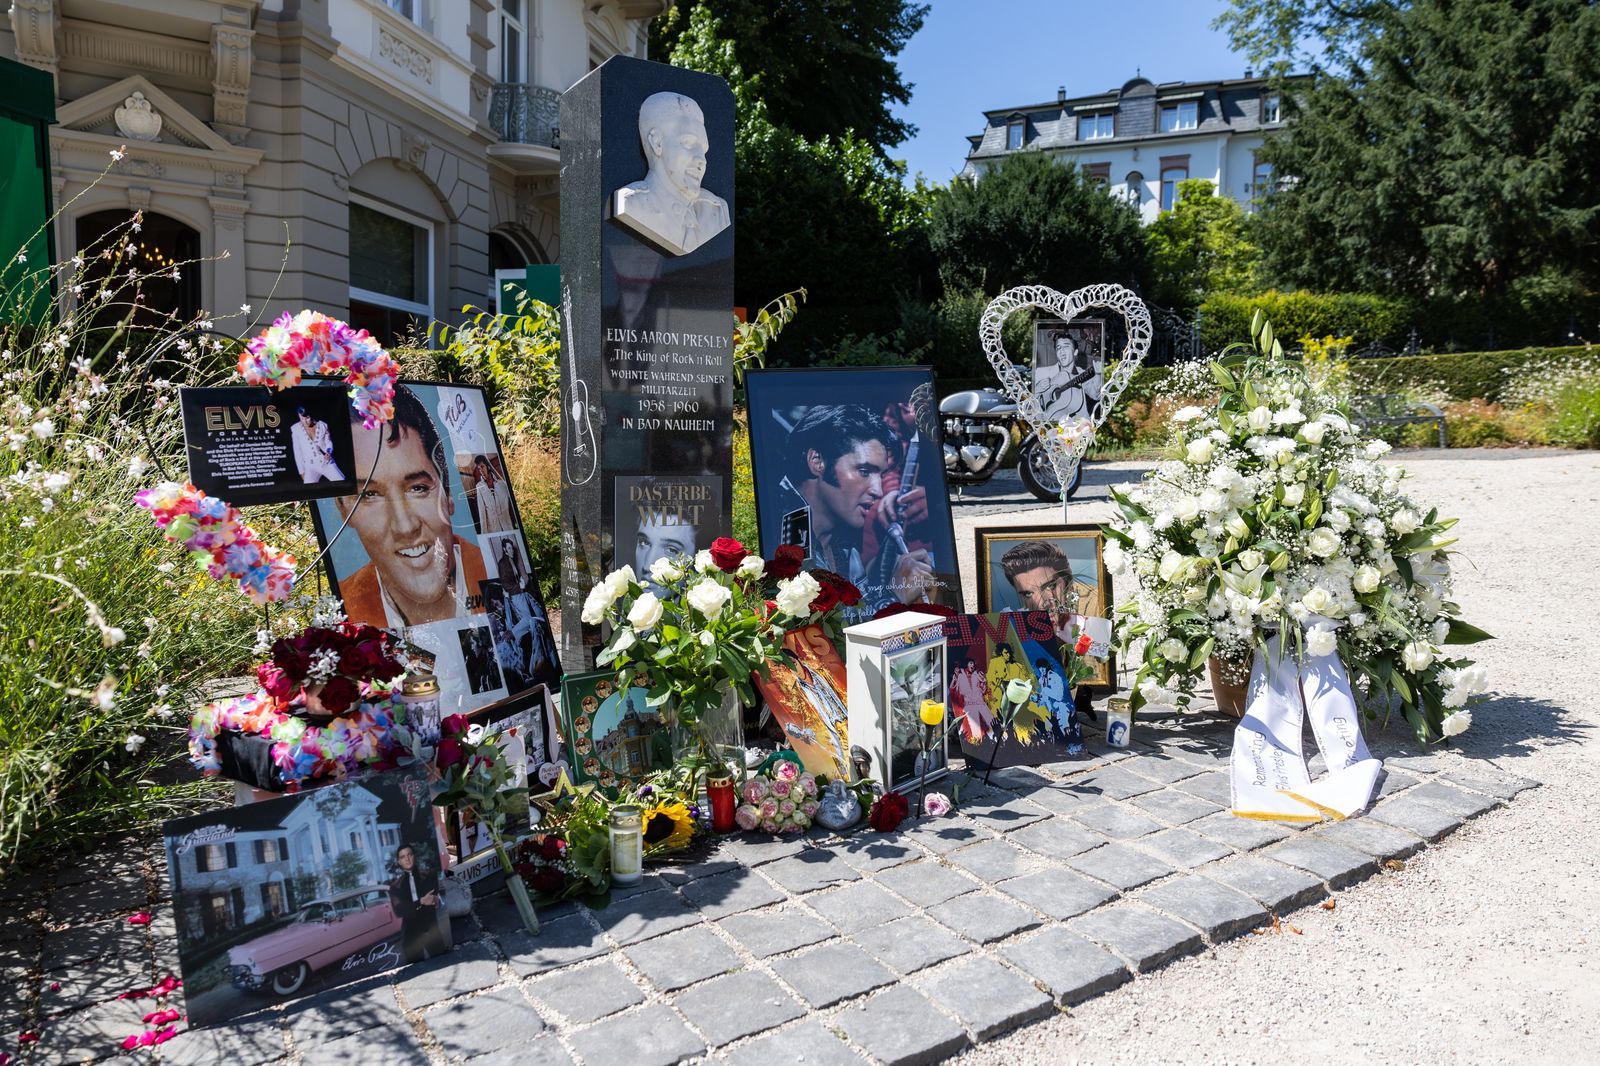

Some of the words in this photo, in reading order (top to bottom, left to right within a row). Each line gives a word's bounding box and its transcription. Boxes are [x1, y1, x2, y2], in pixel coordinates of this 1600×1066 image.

[606, 328, 638, 343] ELVIS
[640, 331, 679, 346] AARON
[683, 333, 728, 349] PRESLEY
[636, 349, 657, 367] King
[660, 352, 669, 362] of
[672, 353, 693, 365] Rock
[705, 355, 722, 366] Roll
[610, 369, 648, 380] WOHNTE
[696, 374, 725, 384] SEINER
[638, 399, 665, 412] 1958
[674, 401, 699, 413] 1960
[205, 405, 281, 430] ELVIS
[622, 417, 634, 430] IN
[638, 417, 660, 430] BAD
[664, 419, 715, 431] NAUHEIM
[208, 428, 280, 437] FOREVER
[630, 485, 662, 501] DAS
[666, 484, 712, 501] ERBE
[637, 504, 705, 527] WELT
[885, 574, 913, 591] whole
[943, 611, 1054, 647] ELVIS
